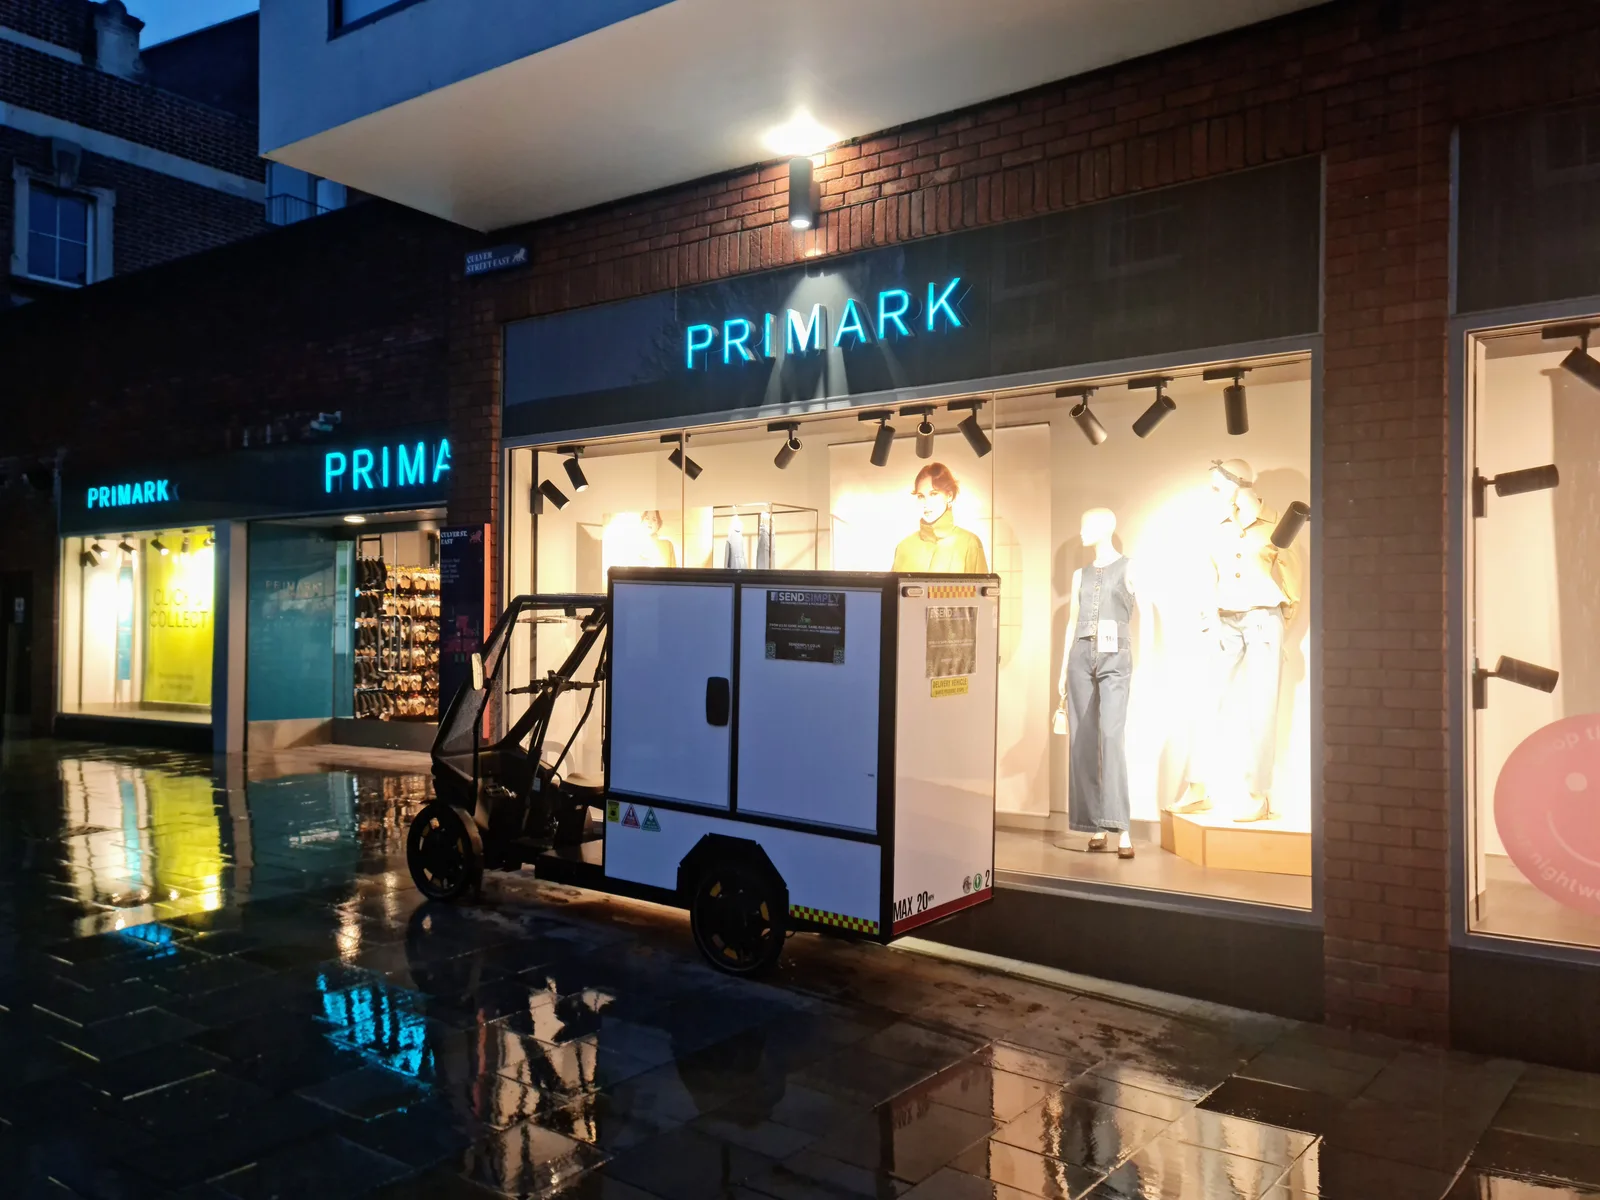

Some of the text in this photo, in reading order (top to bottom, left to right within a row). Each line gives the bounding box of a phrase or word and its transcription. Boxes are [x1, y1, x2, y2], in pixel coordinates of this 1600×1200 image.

[466, 252, 493, 264] CULVER
[466, 256, 511, 273] STREET EAST
[686, 277, 962, 370] PRIMARK
[87, 480, 169, 509] PRIMARK
[779, 592, 840, 604] SENDSIMPLY
[149, 610, 208, 628] COLLECT
[985, 869, 991, 887] 2
[893, 896, 913, 922] MAX
[916, 891, 928, 913] 20
